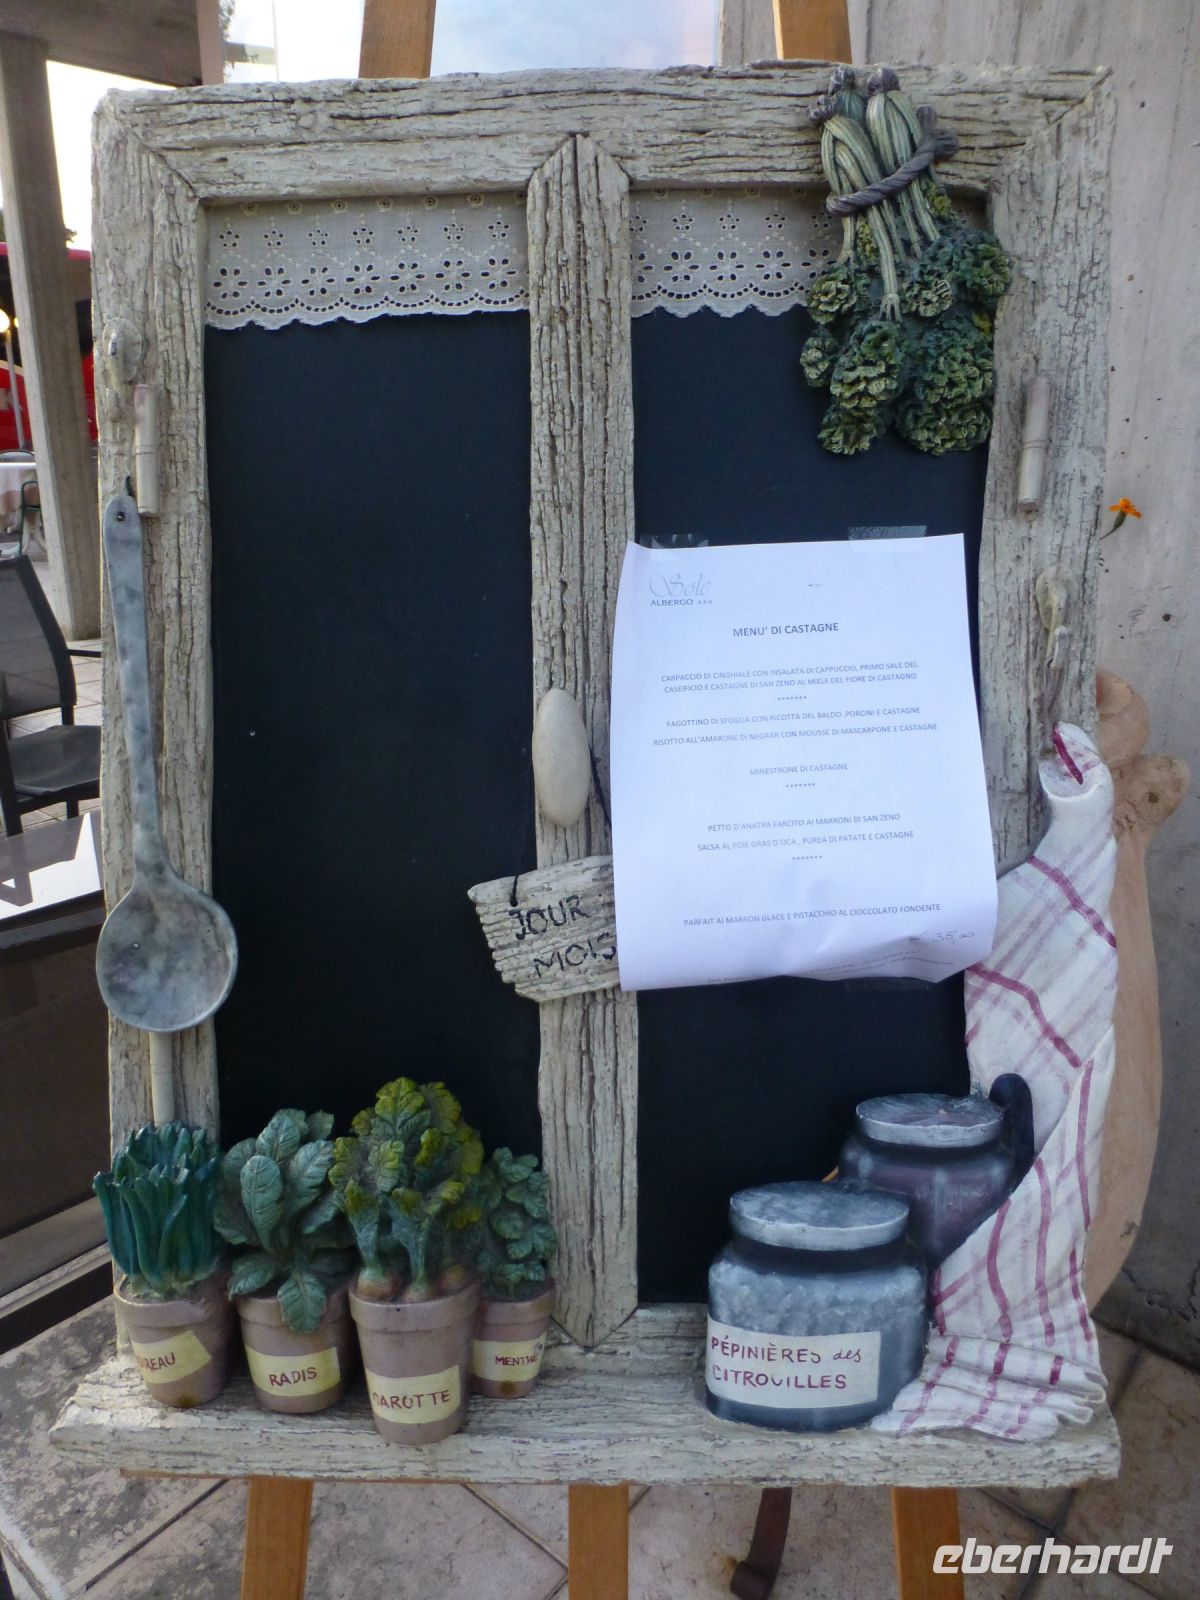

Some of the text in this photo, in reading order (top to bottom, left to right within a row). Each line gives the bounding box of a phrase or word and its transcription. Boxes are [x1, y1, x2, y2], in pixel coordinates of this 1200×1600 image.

[649, 573, 711, 597] Sole
[650, 599, 694, 607] ALBERGO
[771, 626, 782, 635] DI
[784, 622, 840, 634] CASTAGNE
[661, 672, 702, 682] CARPACCIO
[704, 672, 712, 680] DI
[712, 670, 751, 679] CINGHIALE
[752, 670, 769, 678] CON
[770, 667, 805, 676] INSALATA
[860, 663, 884, 671] PRIMO
[664, 684, 702, 693] CASEIFICIO
[710, 682, 749, 690] CASTAGNE
[759, 680, 774, 688] SAN
[776, 679, 796, 687] ZENO
[808, 678, 828, 686] MIELE
[846, 675, 866, 683] FIORE
[878, 673, 917, 681] CASTAGNO
[666, 718, 709, 728] FAGOTTINO
[720, 716, 750, 724] SFOGLIA
[752, 715, 768, 723] CON
[818, 711, 842, 719] BALDO
[882, 707, 921, 716] CASTAGNE
[653, 738, 684, 746] RISOTTO
[749, 732, 780, 740] NEGRAR
[798, 729, 830, 737] MOUSSE
[841, 726, 891, 735] MASCARPONE
[899, 723, 938, 732] CASTAGNE
[750, 766, 798, 776] MINESTRONE
[810, 763, 849, 772] CASTAGNE
[708, 824, 732, 832] PETTO
[772, 819, 805, 828] FARCITO
[816, 816, 852, 825] MARRONI
[862, 814, 878, 822] SAN
[880, 813, 900, 822] ZENO
[697, 843, 720, 852] SALSA
[732, 841, 750, 849] FOIE
[750, 840, 771, 848] GRAS
[802, 836, 828, 845] PUREA
[838, 834, 868, 842] PATATE
[874, 830, 915, 840] CASTAGNE
[508, 895, 592, 940] JOUR
[684, 917, 715, 926] PARFAIT
[725, 914, 760, 924] MARRON
[761, 913, 785, 922] GLACE
[793, 910, 837, 920] PISTACCHIO
[850, 906, 898, 916] CIOCCOLATO
[900, 904, 941, 913] FONDENTE
[533, 932, 617, 979] MOIS
[711, 1335, 862, 1364] PÉPINIÈRES des
[268, 1366, 318, 1387] RADIS
[712, 1364, 847, 1390] CITROUILLES
[372, 1389, 450, 1410] CAROTTE
